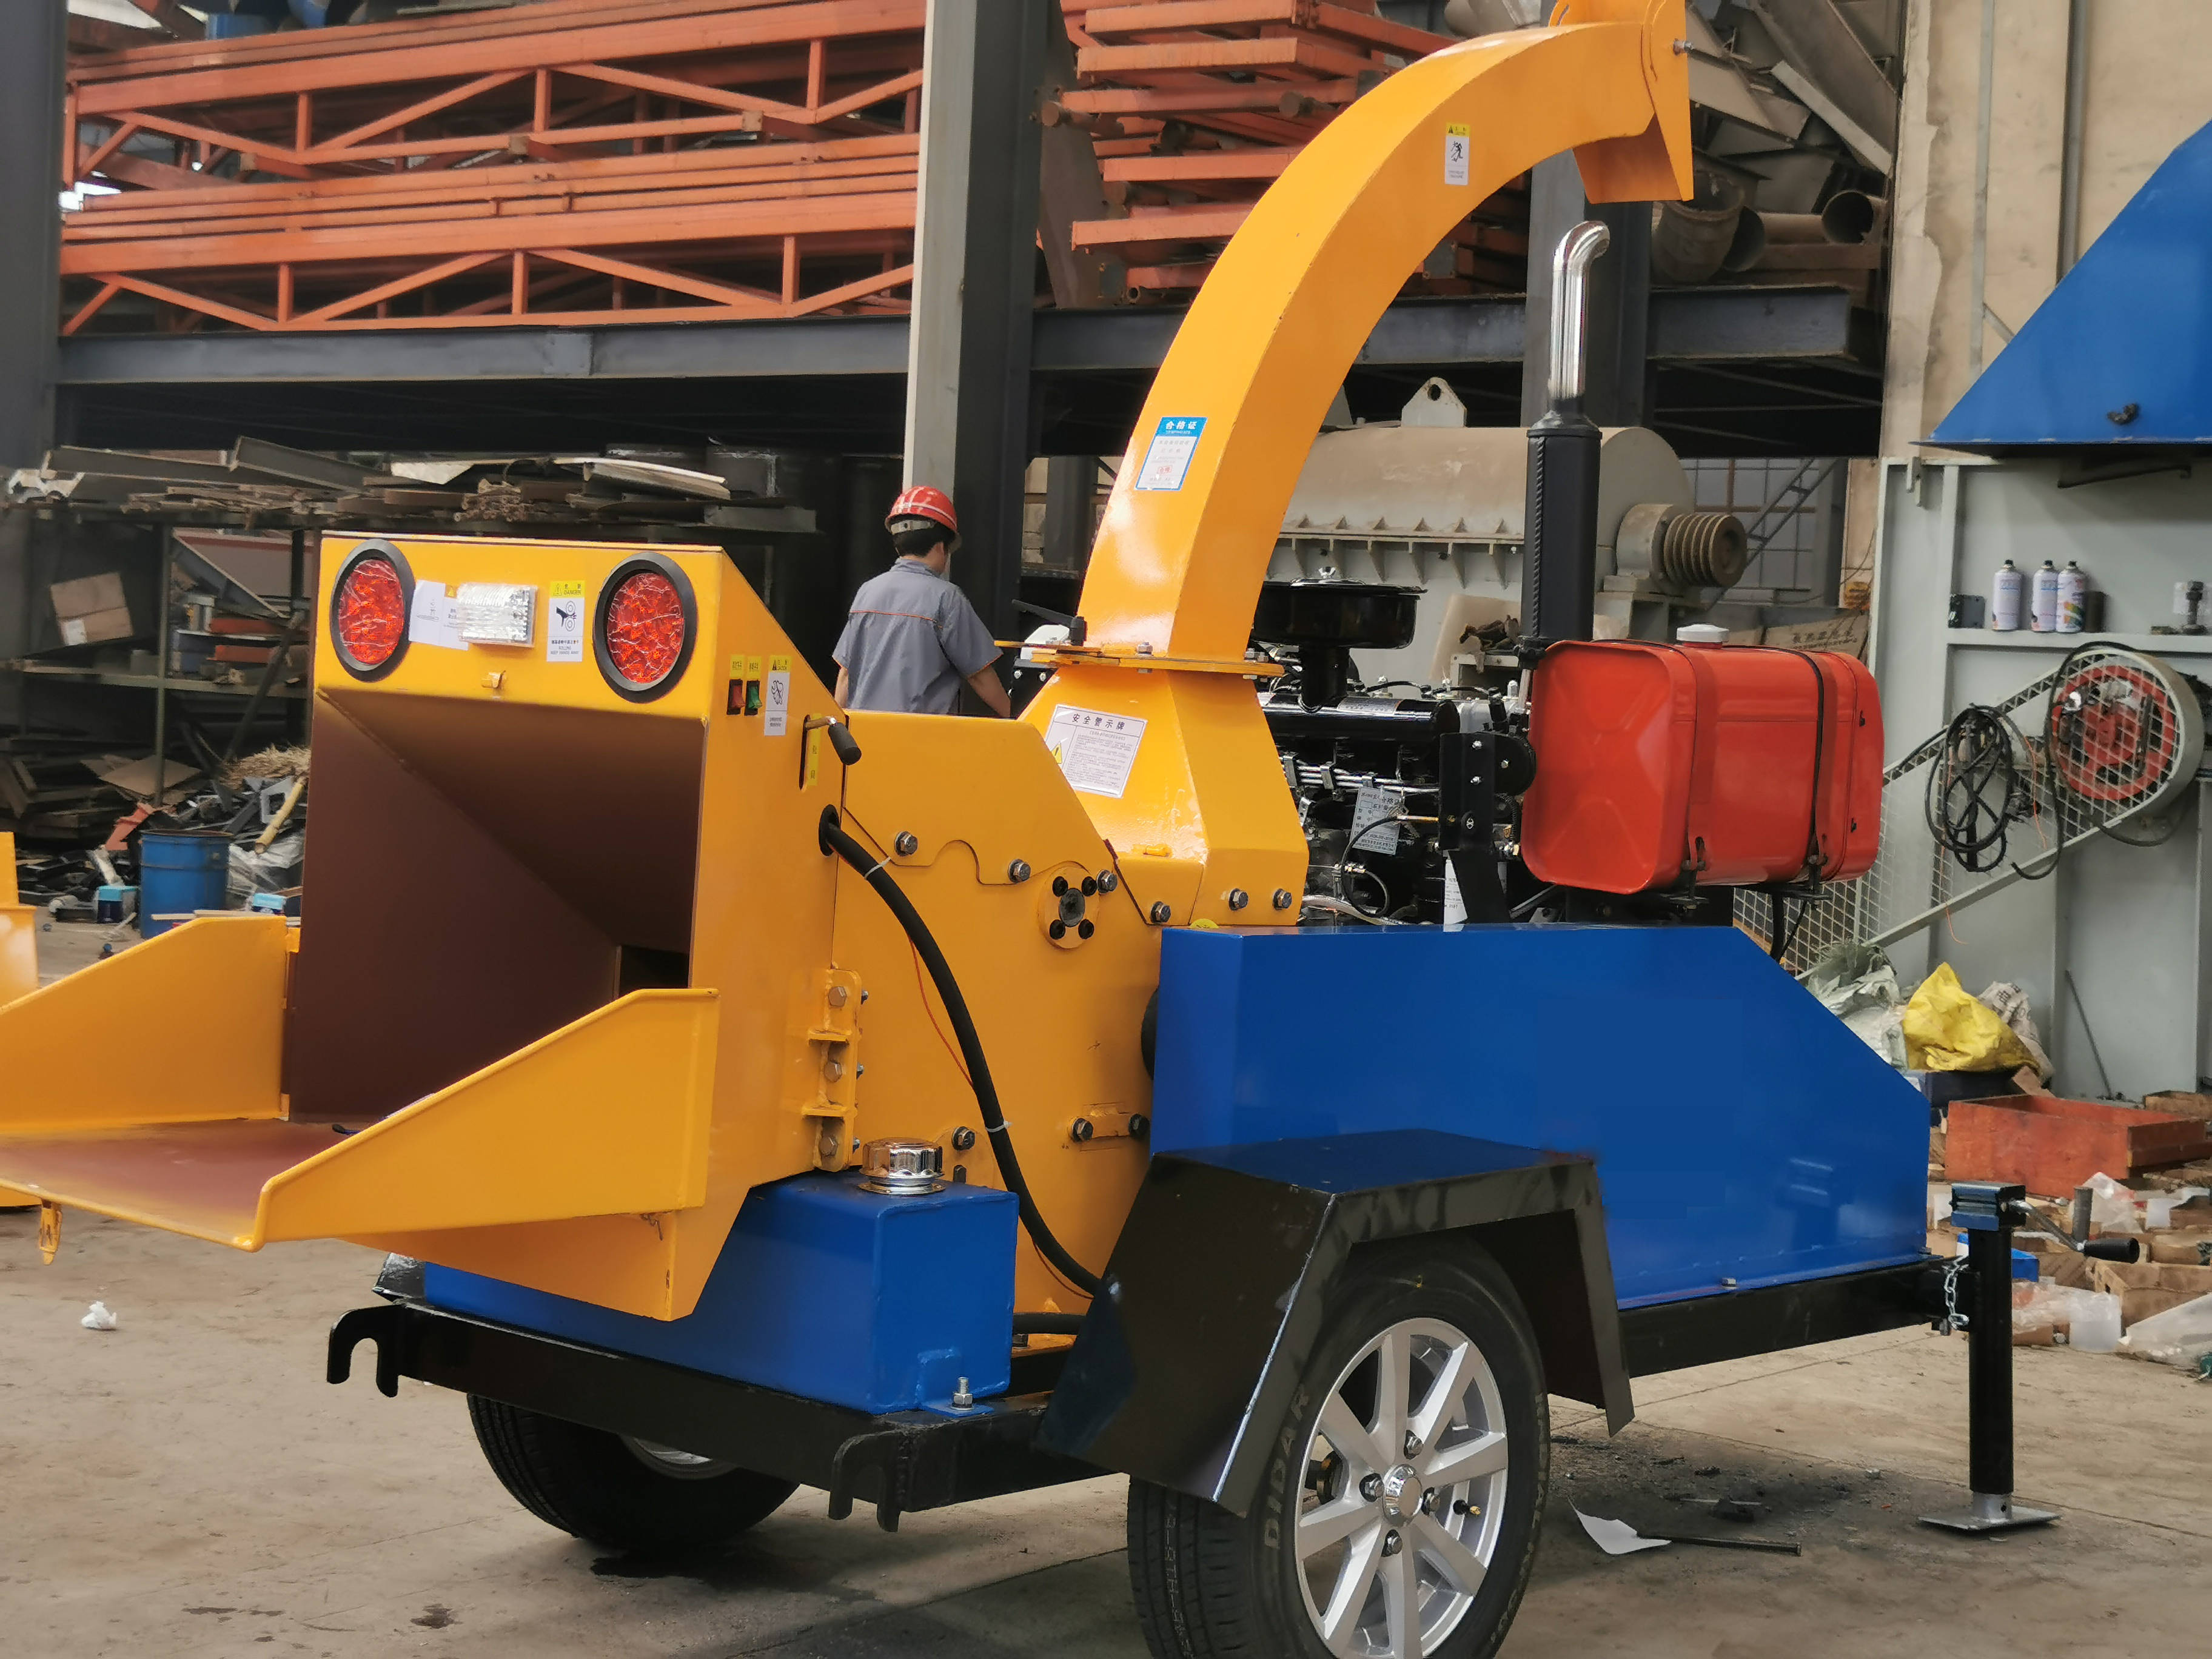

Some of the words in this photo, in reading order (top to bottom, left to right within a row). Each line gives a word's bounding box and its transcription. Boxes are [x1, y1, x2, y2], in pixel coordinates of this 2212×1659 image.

[1165, 421, 1197, 430] 合格证
[1071, 713, 1125, 731] 安全警示牌
